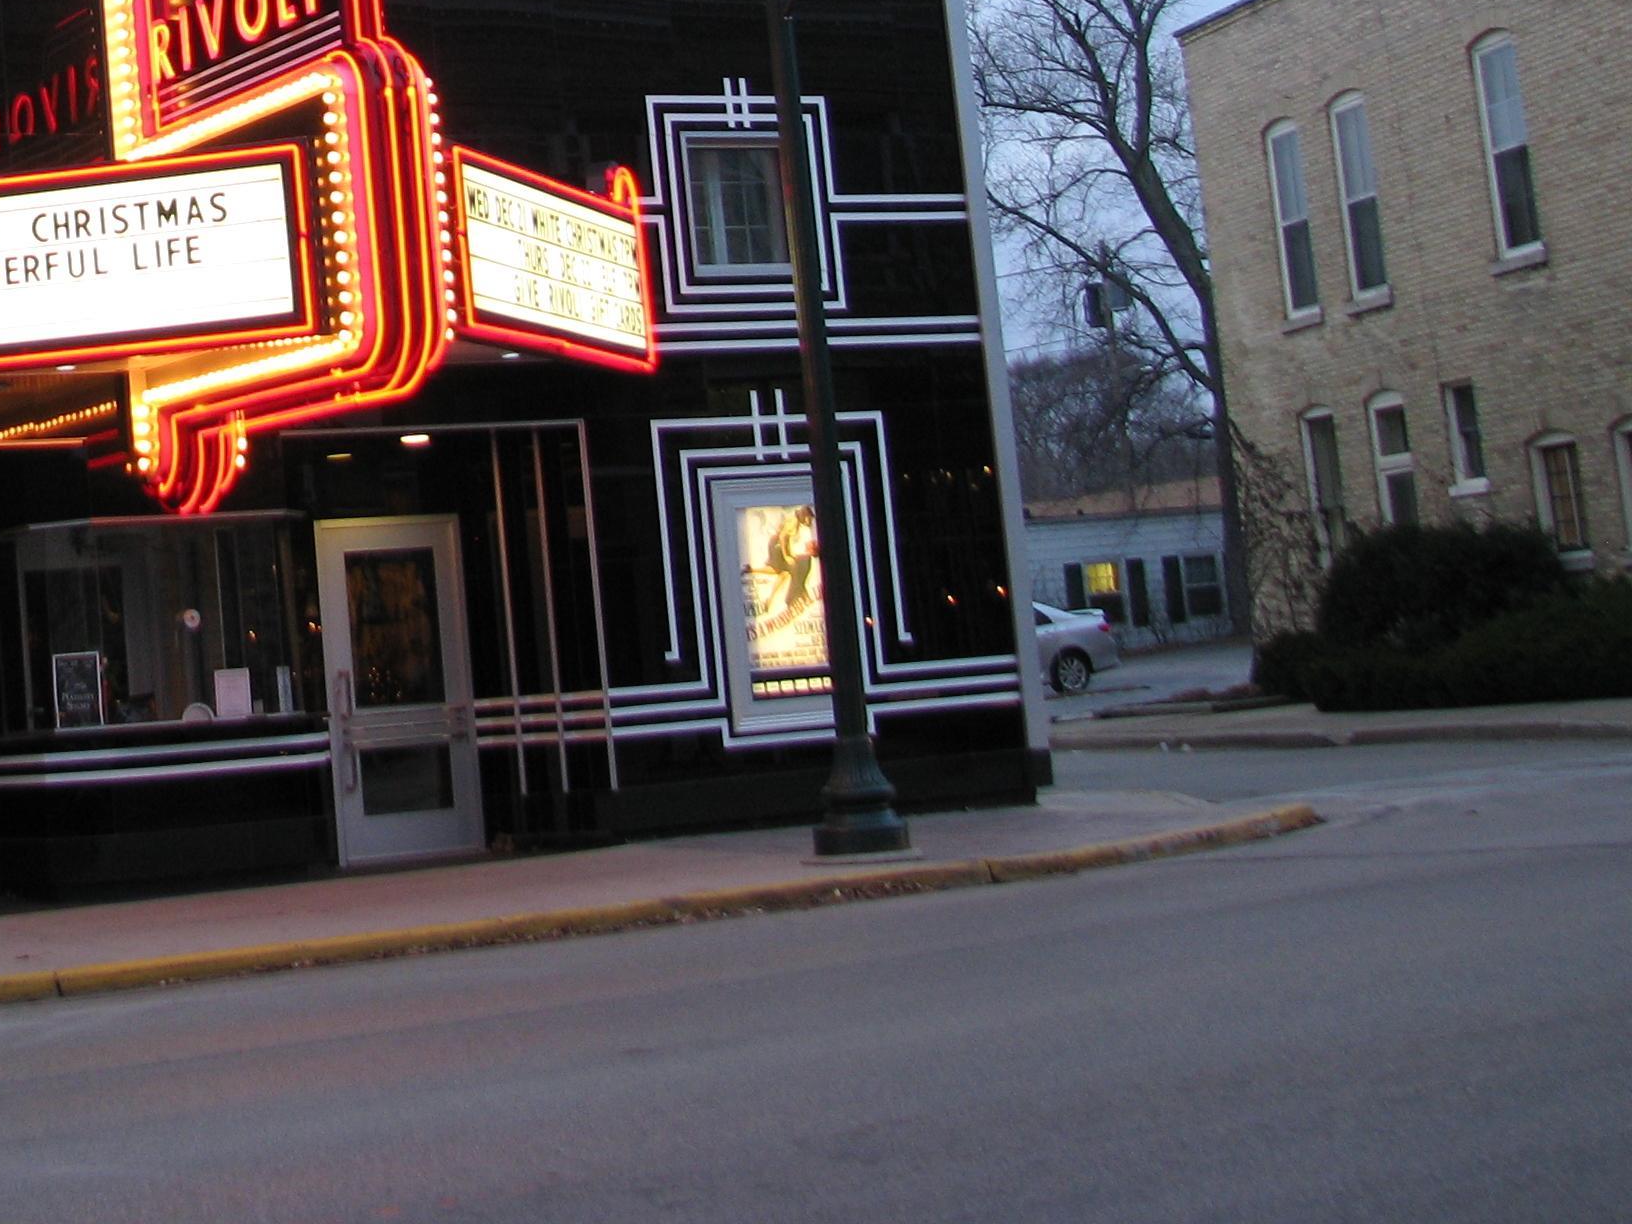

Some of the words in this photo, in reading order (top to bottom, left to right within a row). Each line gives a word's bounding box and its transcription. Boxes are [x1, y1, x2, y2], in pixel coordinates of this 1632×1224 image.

[31, 192, 228, 244] CHRISTMAS
[467, 185, 489, 219] WED
[495, 195, 515, 229] DEC
[531, 208, 561, 243] WHITE
[565, 218, 619, 262] CHRISTMAS
[134, 235, 203, 270] LIFE
[517, 238, 550, 275] THURS
